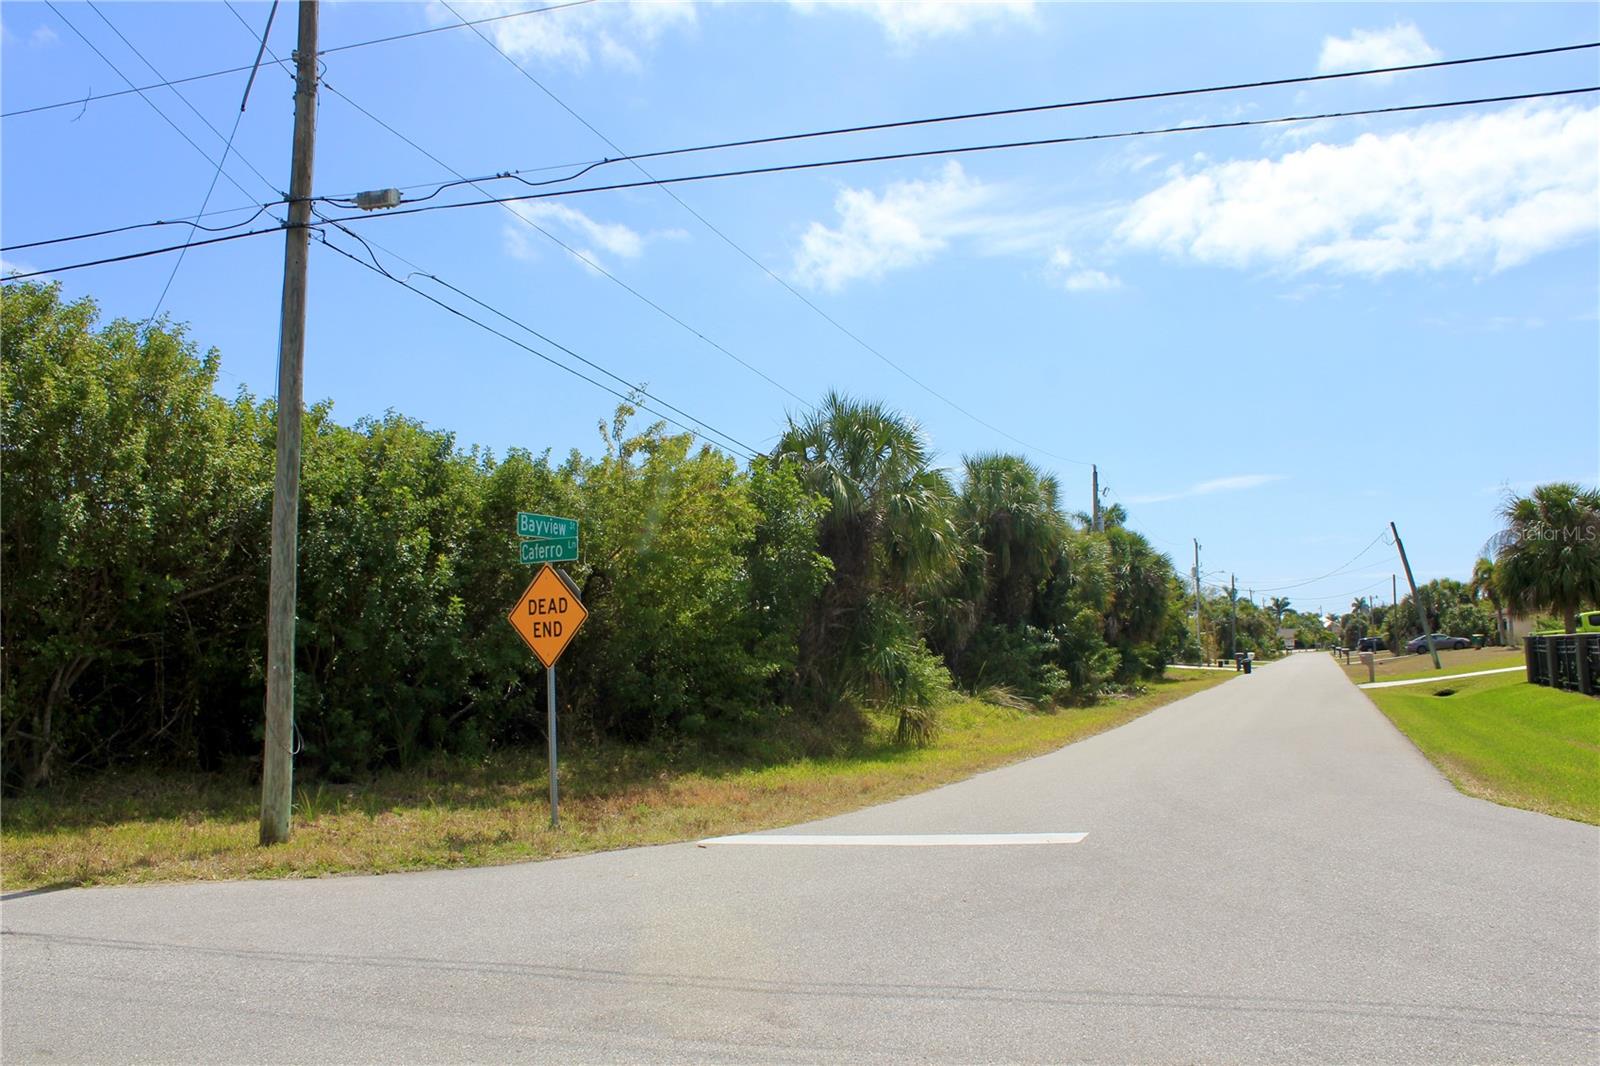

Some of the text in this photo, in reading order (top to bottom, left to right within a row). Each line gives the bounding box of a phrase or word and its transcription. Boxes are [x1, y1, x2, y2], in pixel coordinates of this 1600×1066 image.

[520, 514, 566, 536] Bayview
[521, 540, 577, 560] Caferro Ln
[528, 597, 568, 616] DEAD
[533, 620, 563, 638] END
